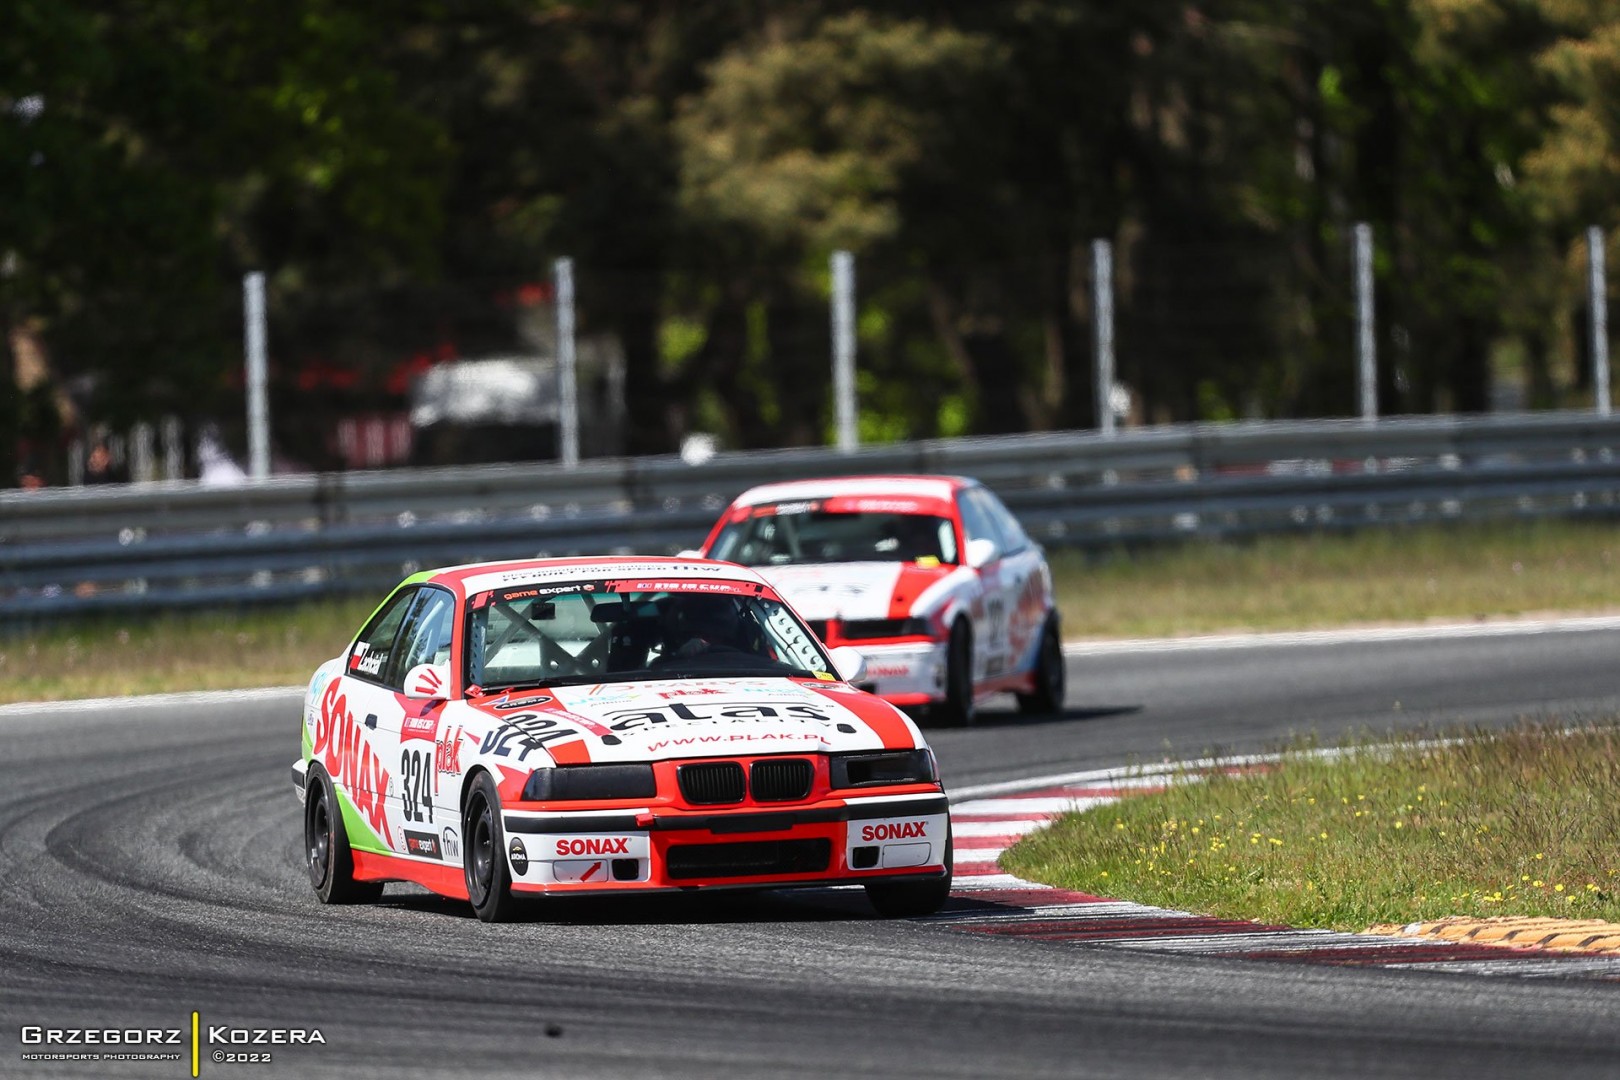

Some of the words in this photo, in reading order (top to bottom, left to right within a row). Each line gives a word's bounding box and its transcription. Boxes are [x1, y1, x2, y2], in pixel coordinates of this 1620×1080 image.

[503, 589, 538, 600] game
[539, 585, 581, 595] expert
[480, 714, 579, 762] 324
[647, 733, 832, 752] WWW.PLAK.PL
[314, 675, 395, 851] SONAX
[401, 748, 434, 824] 324
[862, 821, 927, 842] SONAX
[555, 837, 629, 857] SONAX
